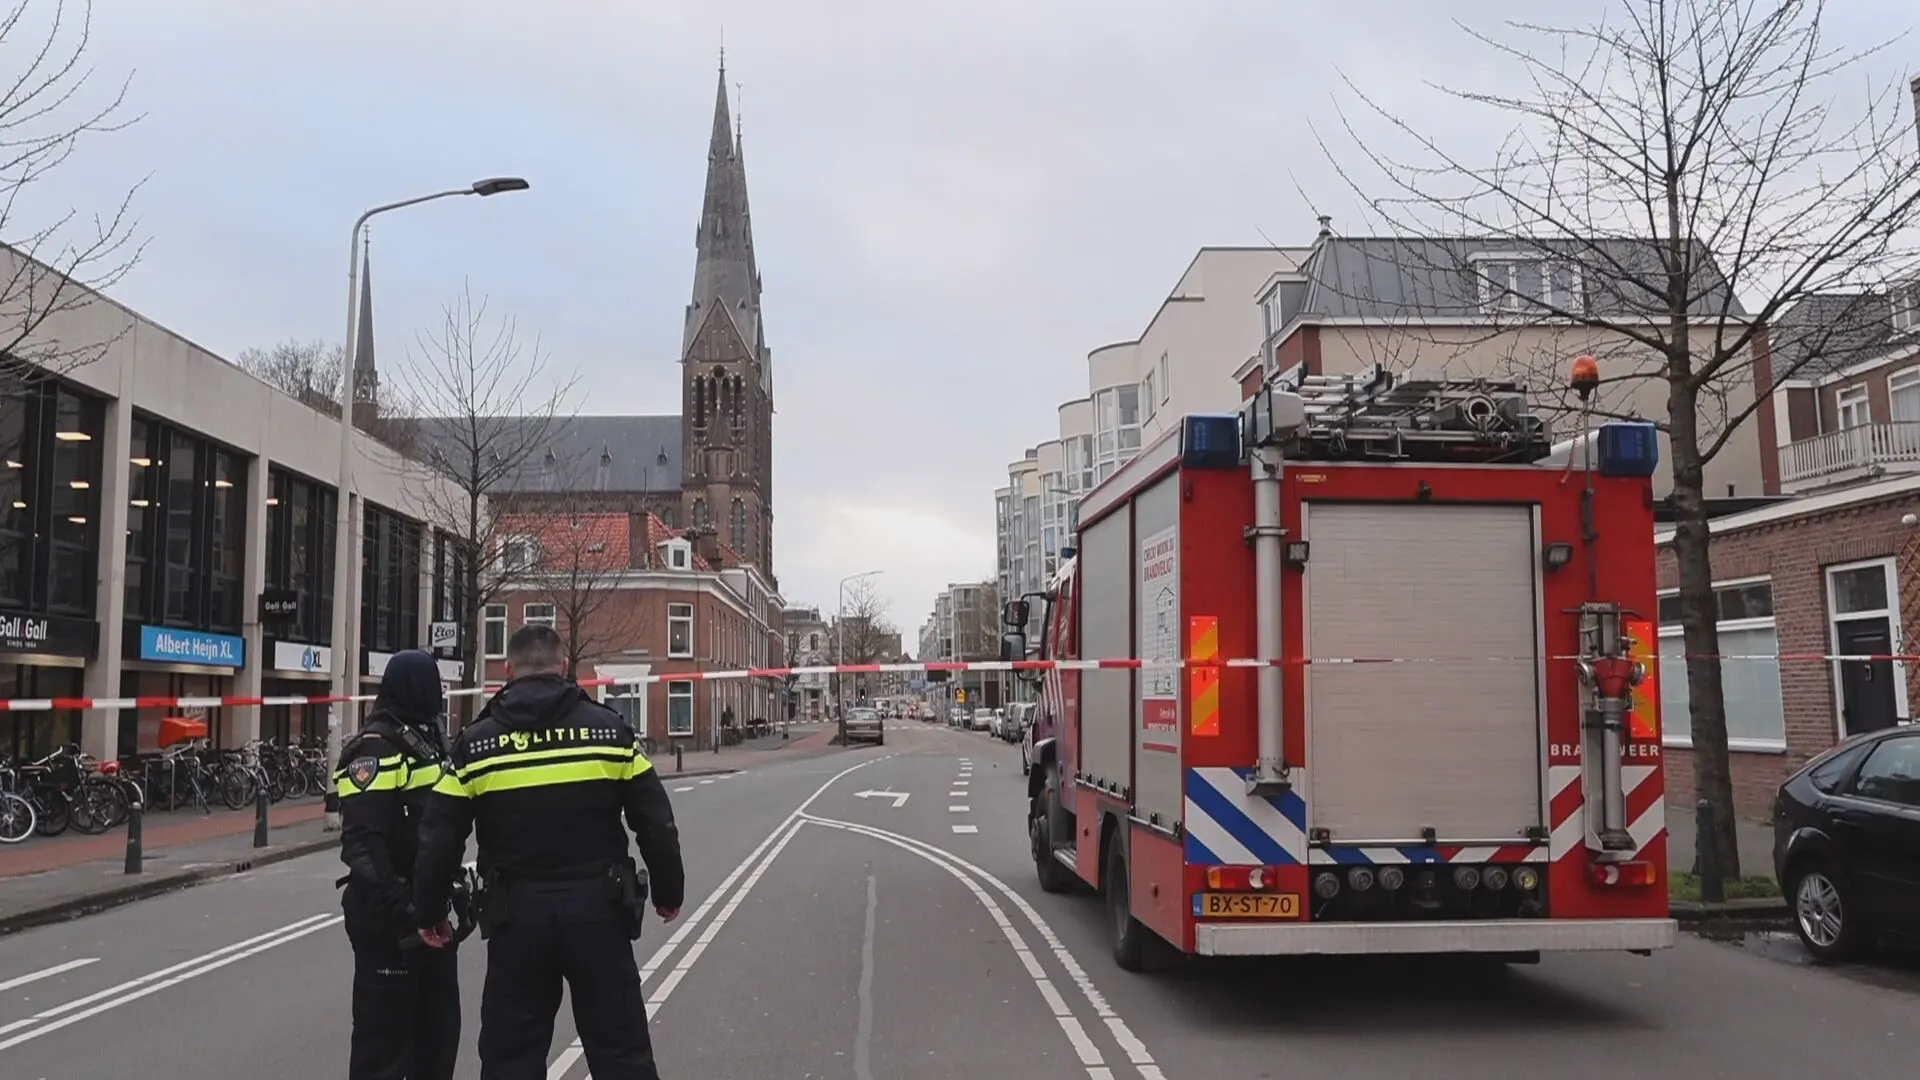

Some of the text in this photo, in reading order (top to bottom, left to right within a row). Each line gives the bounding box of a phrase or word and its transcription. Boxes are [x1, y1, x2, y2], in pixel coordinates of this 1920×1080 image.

[25, 618, 48, 640] Gall
[434, 625, 456, 642] Etos
[155, 633, 233, 660] Albert Heijn XL
[312, 652, 322, 668] XL
[499, 727, 590, 751] POLITIE
[1210, 896, 1292, 914] BX-ST-70
